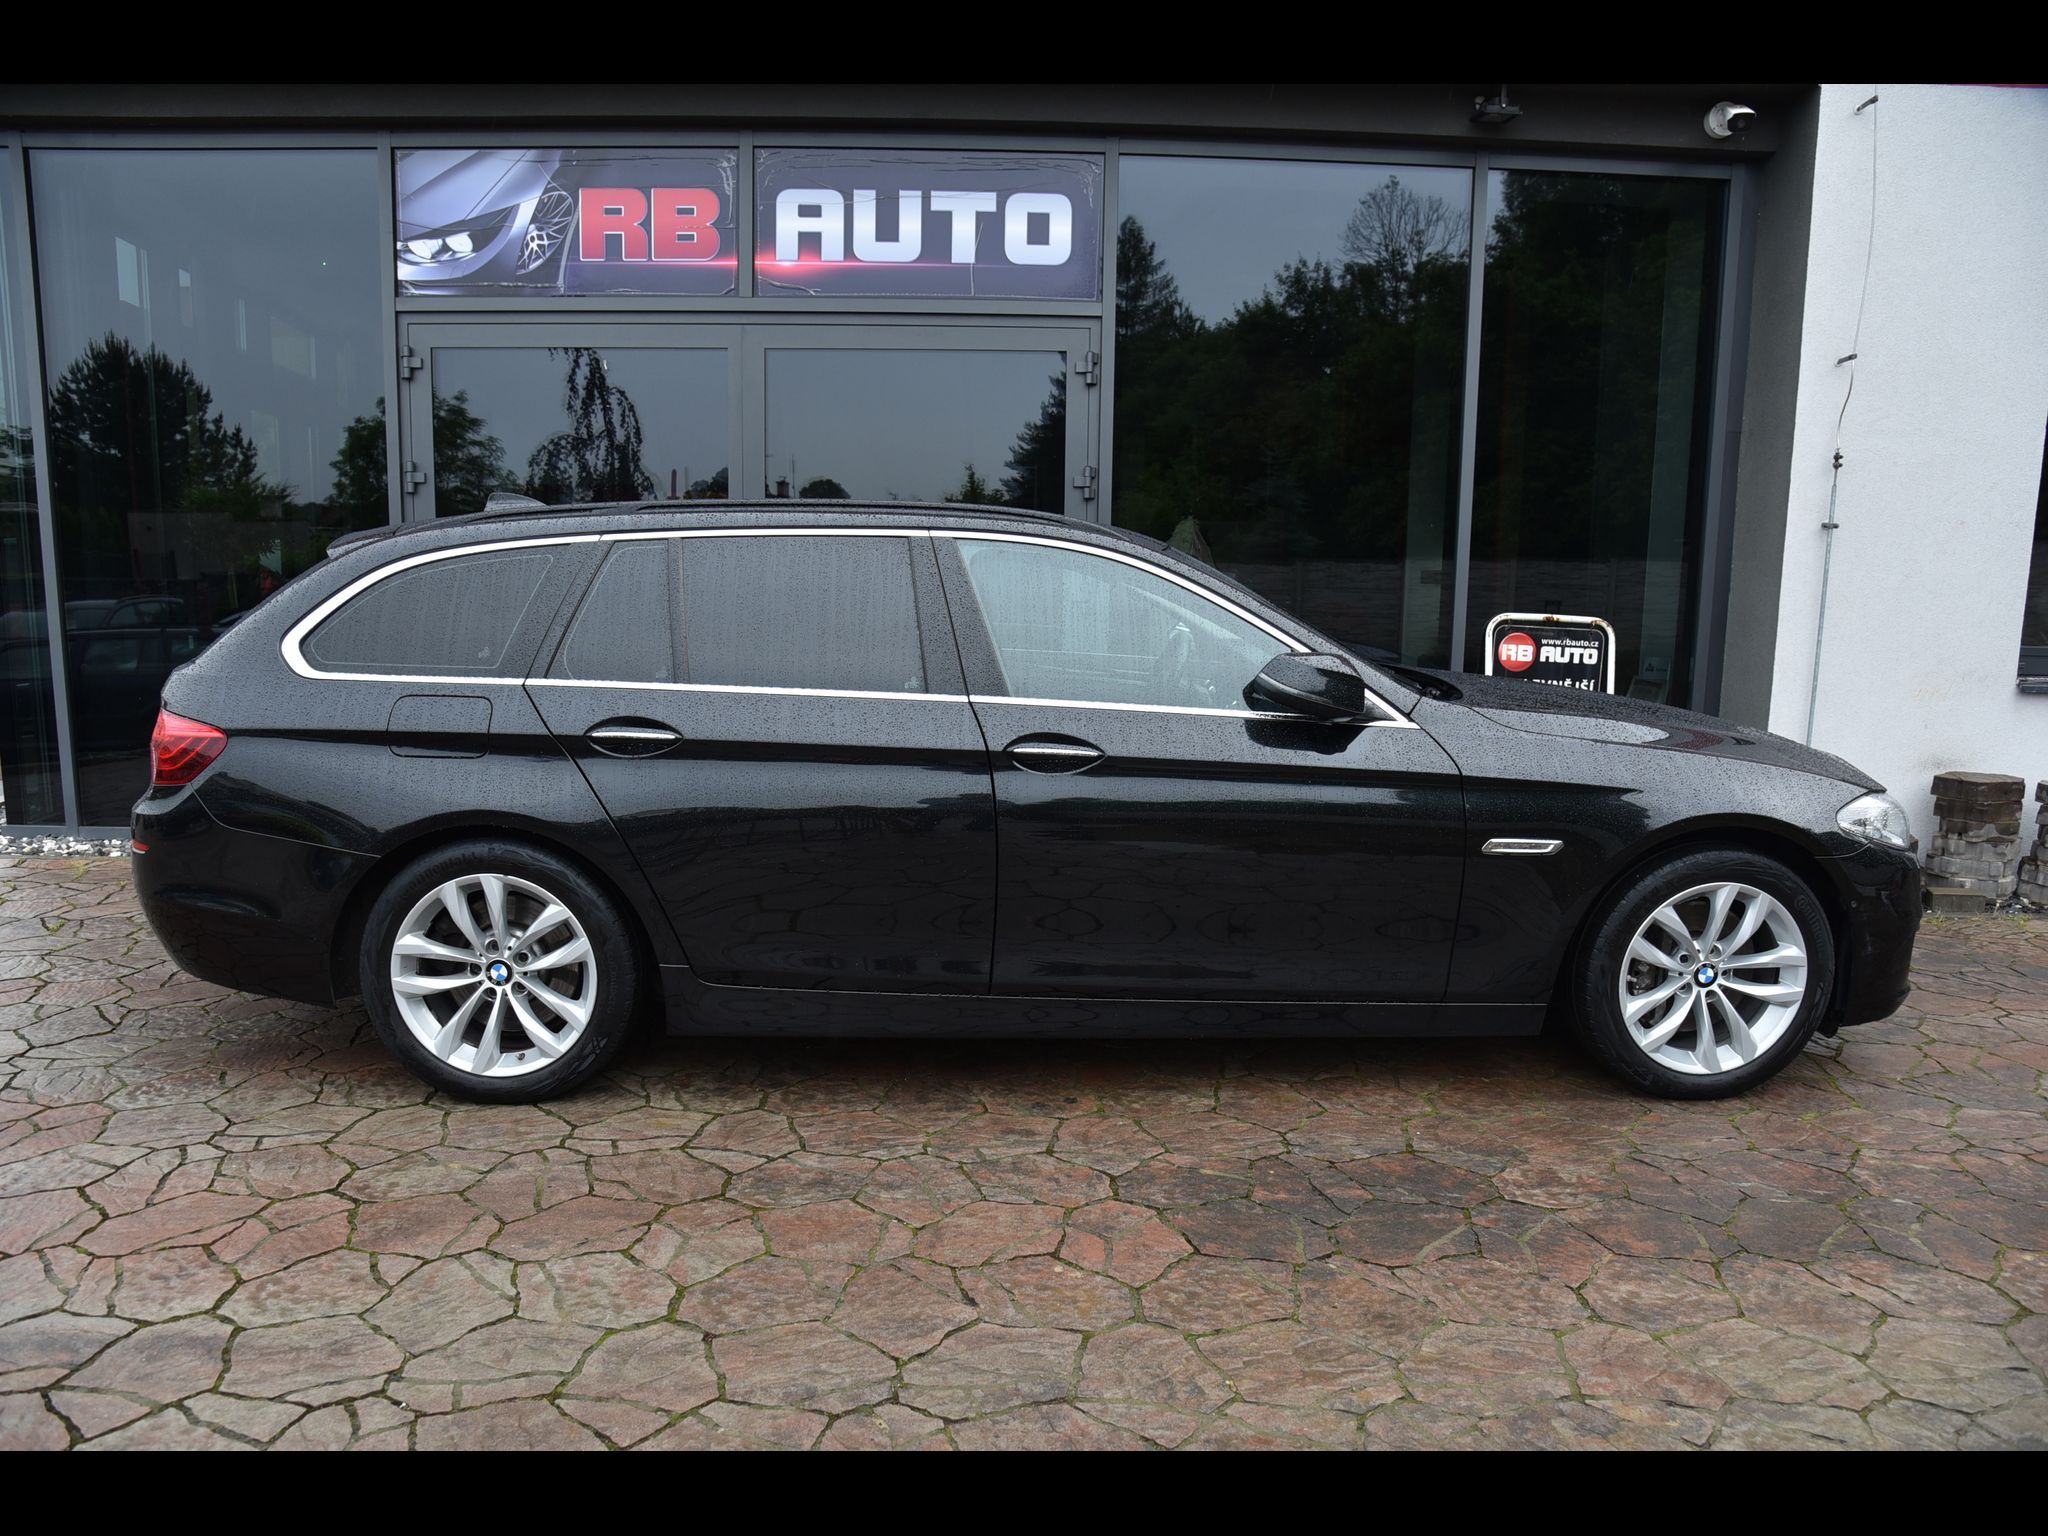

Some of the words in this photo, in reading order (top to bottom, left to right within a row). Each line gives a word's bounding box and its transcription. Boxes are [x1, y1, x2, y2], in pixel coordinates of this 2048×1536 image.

[579, 188, 720, 261] RB
[776, 188, 1072, 266] AUTO
[1541, 638, 1599, 647] www.rbauto.cz
[1501, 643, 1534, 662] RB
[1539, 645, 1599, 665] AUTO
